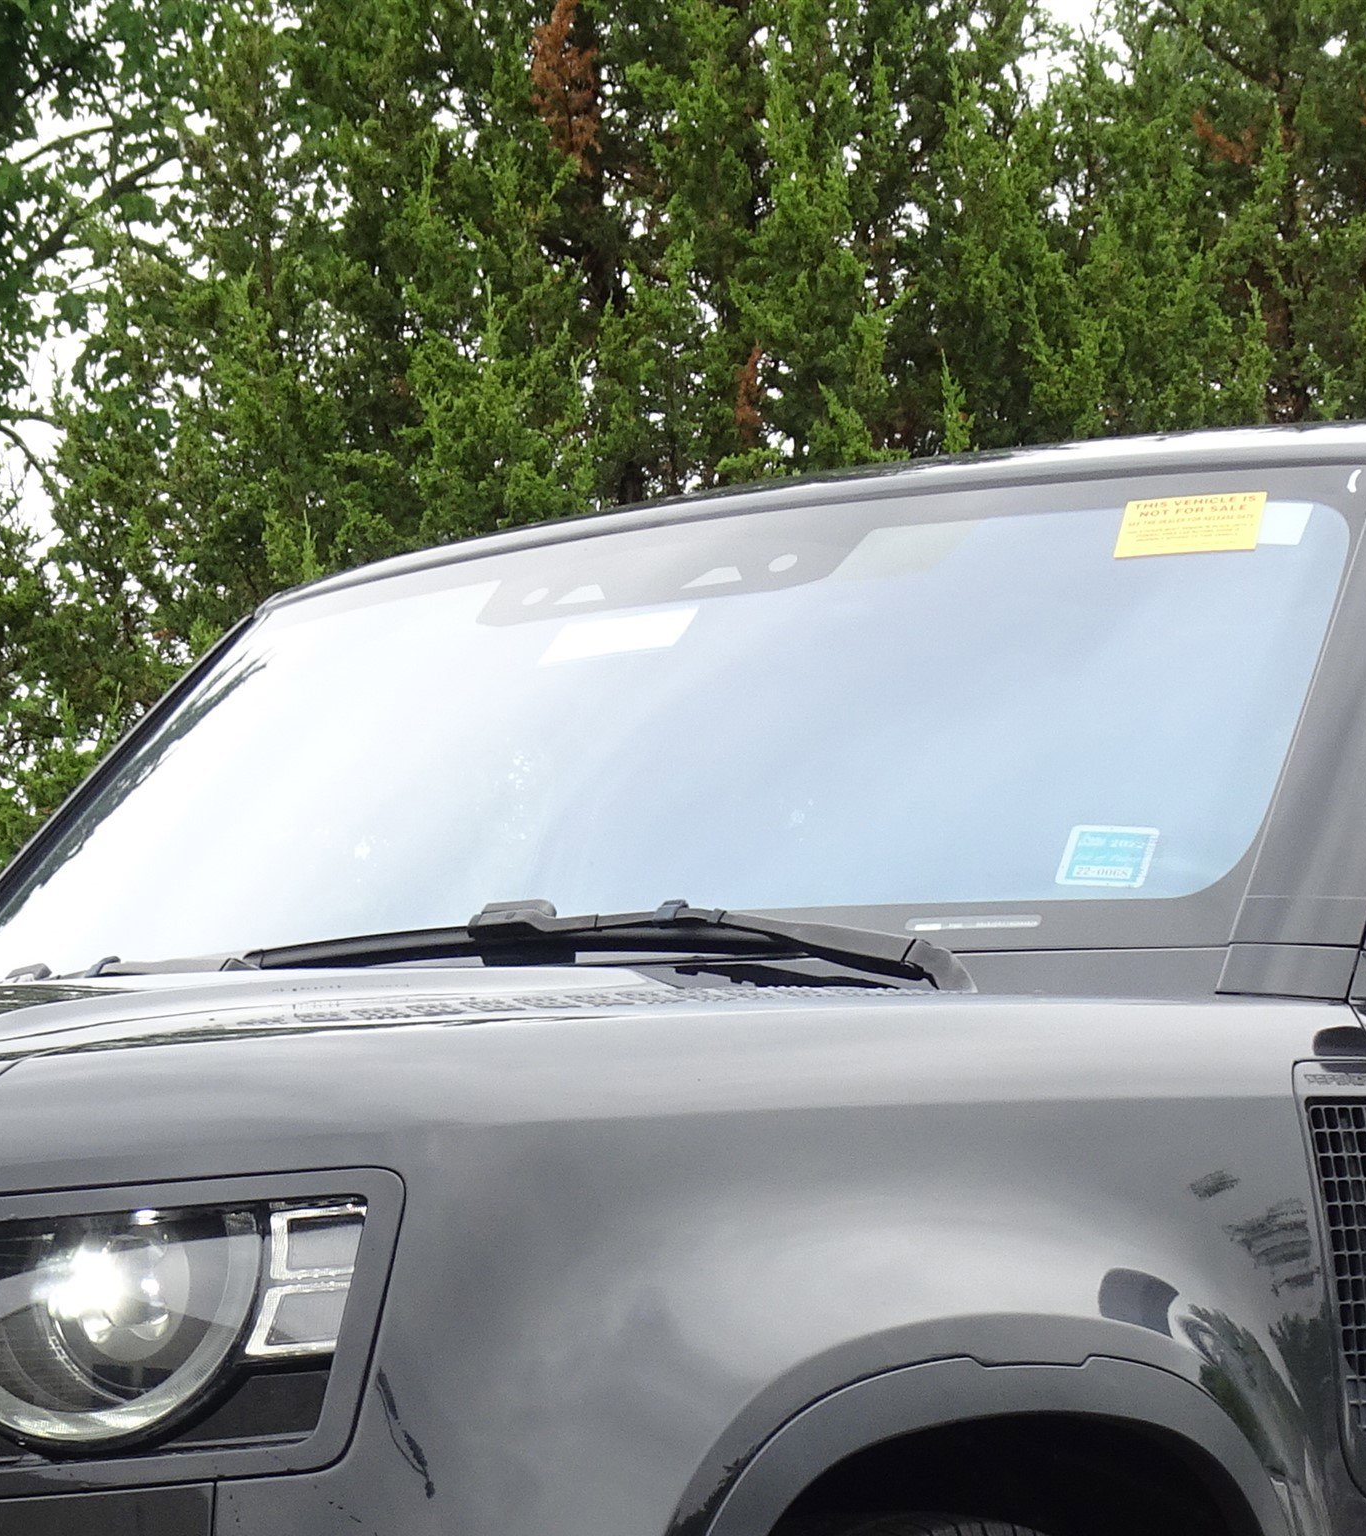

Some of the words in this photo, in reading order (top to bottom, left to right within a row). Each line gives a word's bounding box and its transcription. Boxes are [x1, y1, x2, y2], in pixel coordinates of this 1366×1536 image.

[1134, 501, 1168, 509] THIS
[1173, 496, 1236, 506] VEHICLE
[1139, 509, 1169, 517] NOT
[1209, 504, 1246, 512] SALE
